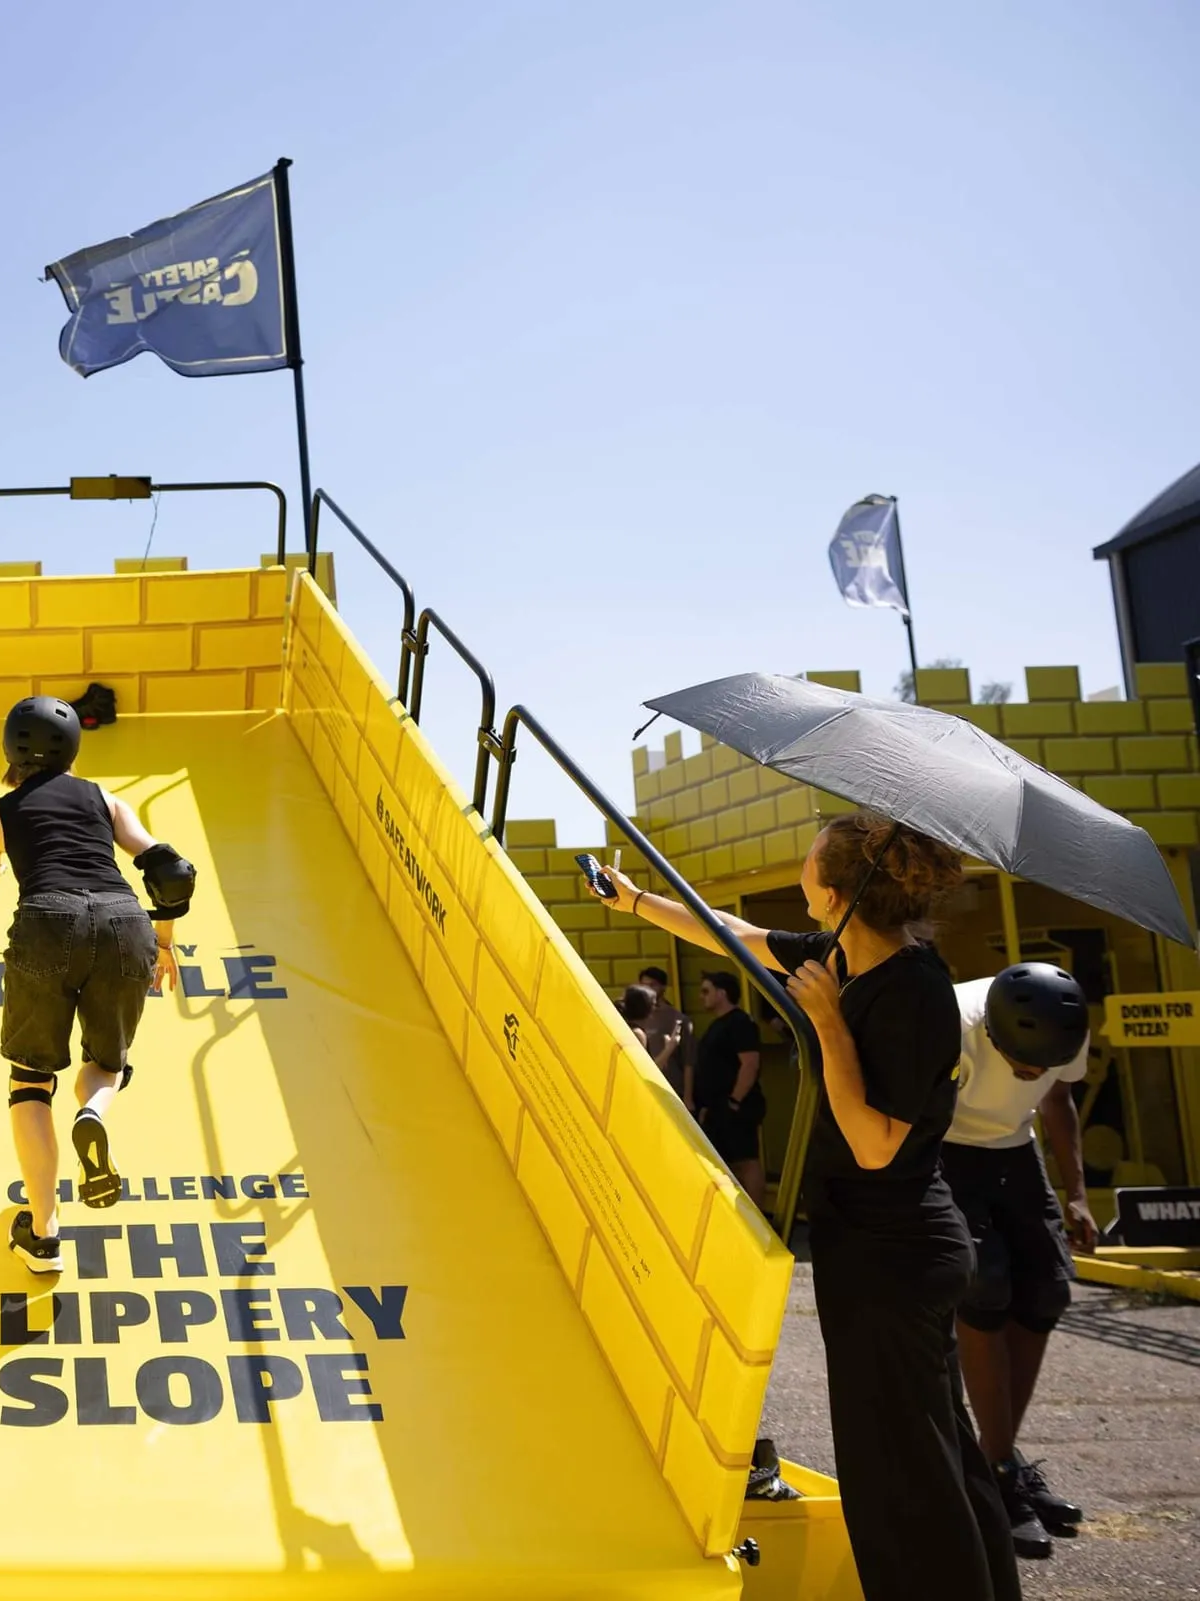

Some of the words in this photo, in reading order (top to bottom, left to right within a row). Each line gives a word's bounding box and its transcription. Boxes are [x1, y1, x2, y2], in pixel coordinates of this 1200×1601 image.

[1121, 1004, 1163, 1019] DOWN
[1166, 1002, 1193, 1018] FOR
[1123, 1022, 1169, 1037] PIZZA?
[7, 1173, 311, 1205] CHLLENGE
[58, 1221, 276, 1280] THE
